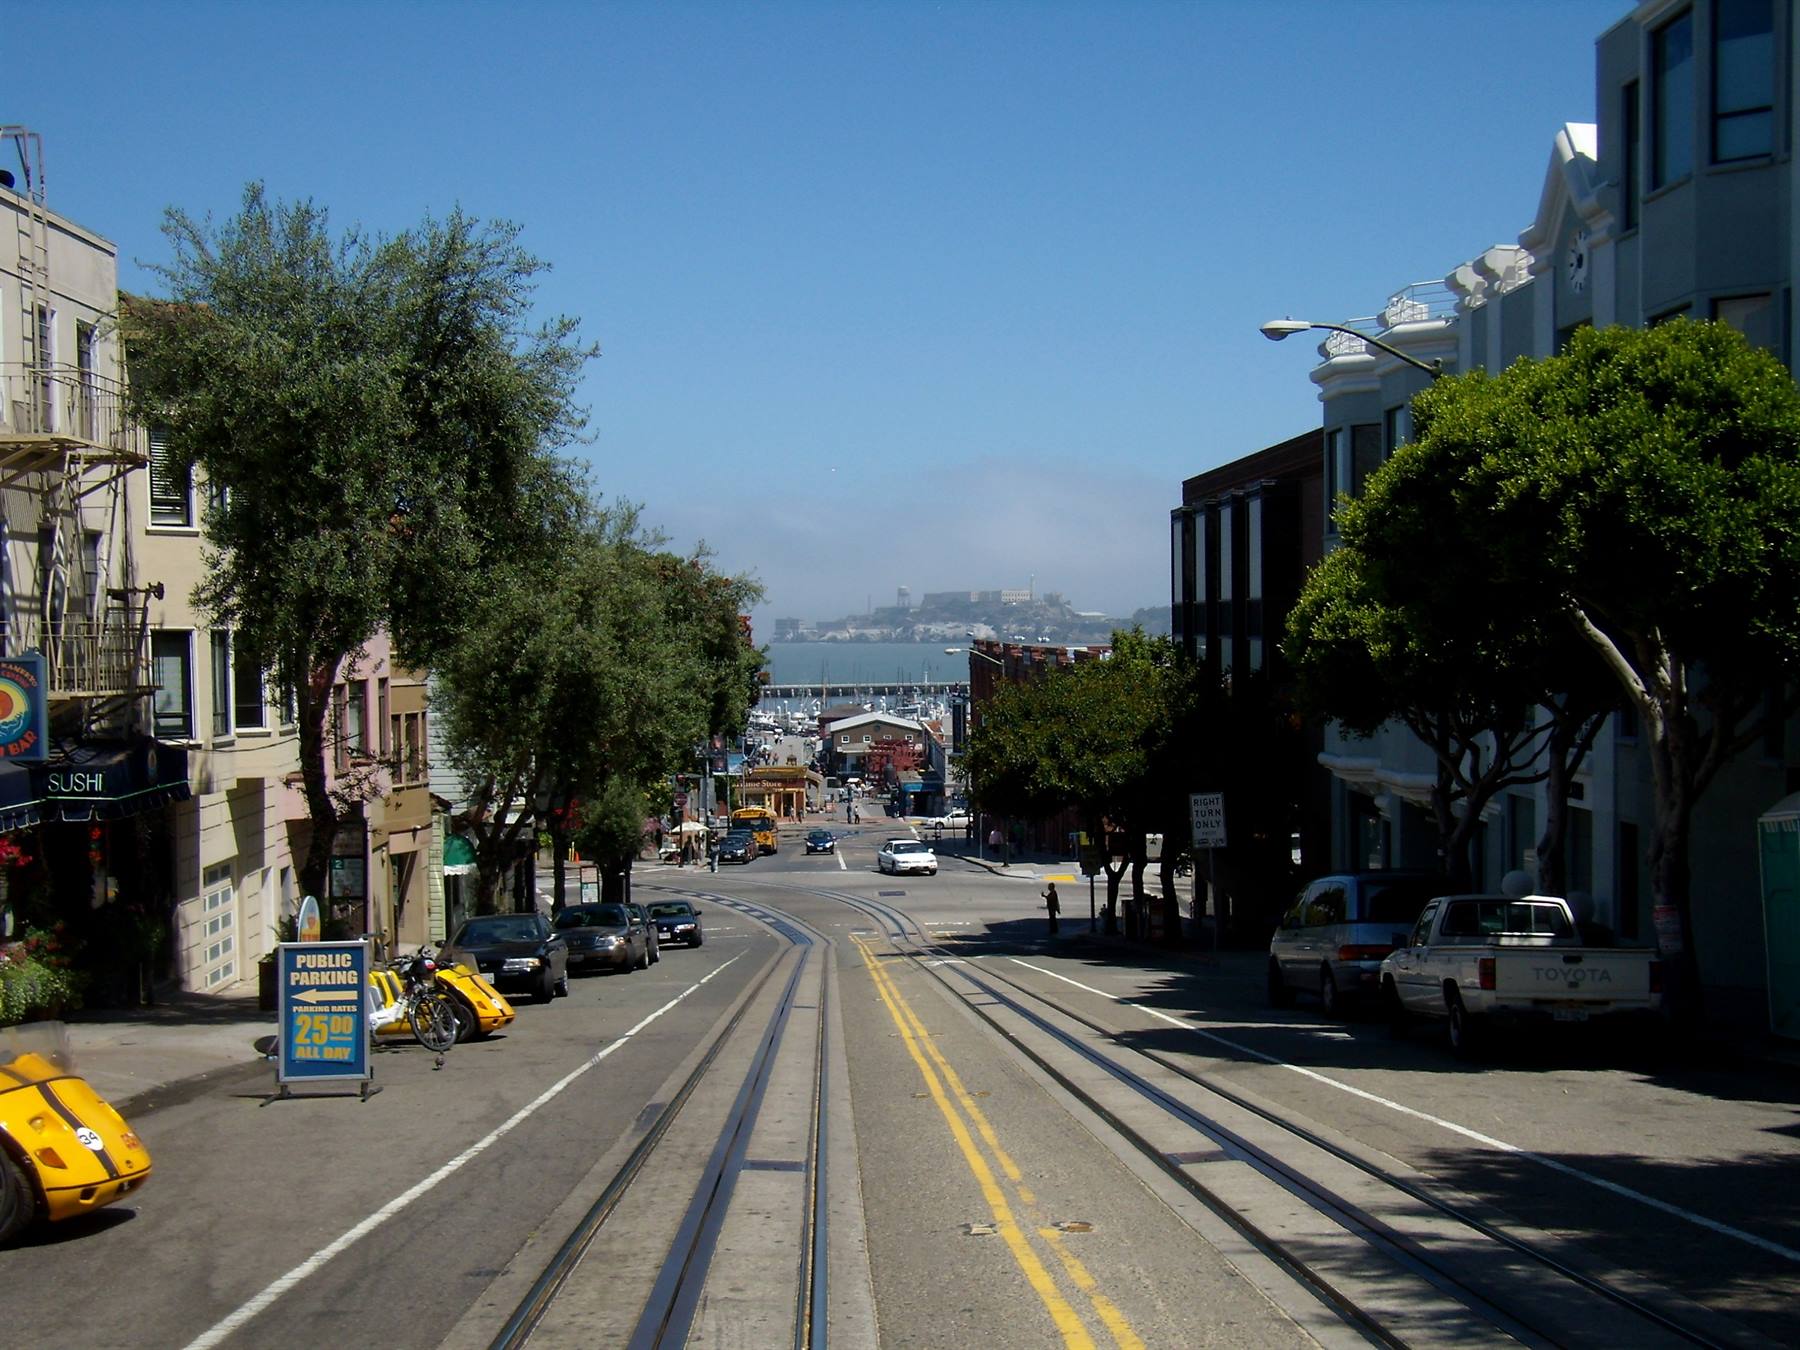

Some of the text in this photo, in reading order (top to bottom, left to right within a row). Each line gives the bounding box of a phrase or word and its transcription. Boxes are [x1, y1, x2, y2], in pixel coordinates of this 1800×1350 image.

[8, 730, 37, 756] BAR
[48, 772, 102, 792] SUSHI
[1193, 797, 1220, 807] RIGHT
[1194, 808, 1221, 818] TURN
[1195, 820, 1221, 829] ONLY
[296, 953, 352, 969] PUBLIC
[290, 970, 358, 986] PARKING
[1532, 967, 1612, 982] TOYOTA
[292, 1005, 358, 1013] PARKING RATES
[296, 1046, 352, 1060] ALL DAY
[79, 1131, 100, 1145] 34
